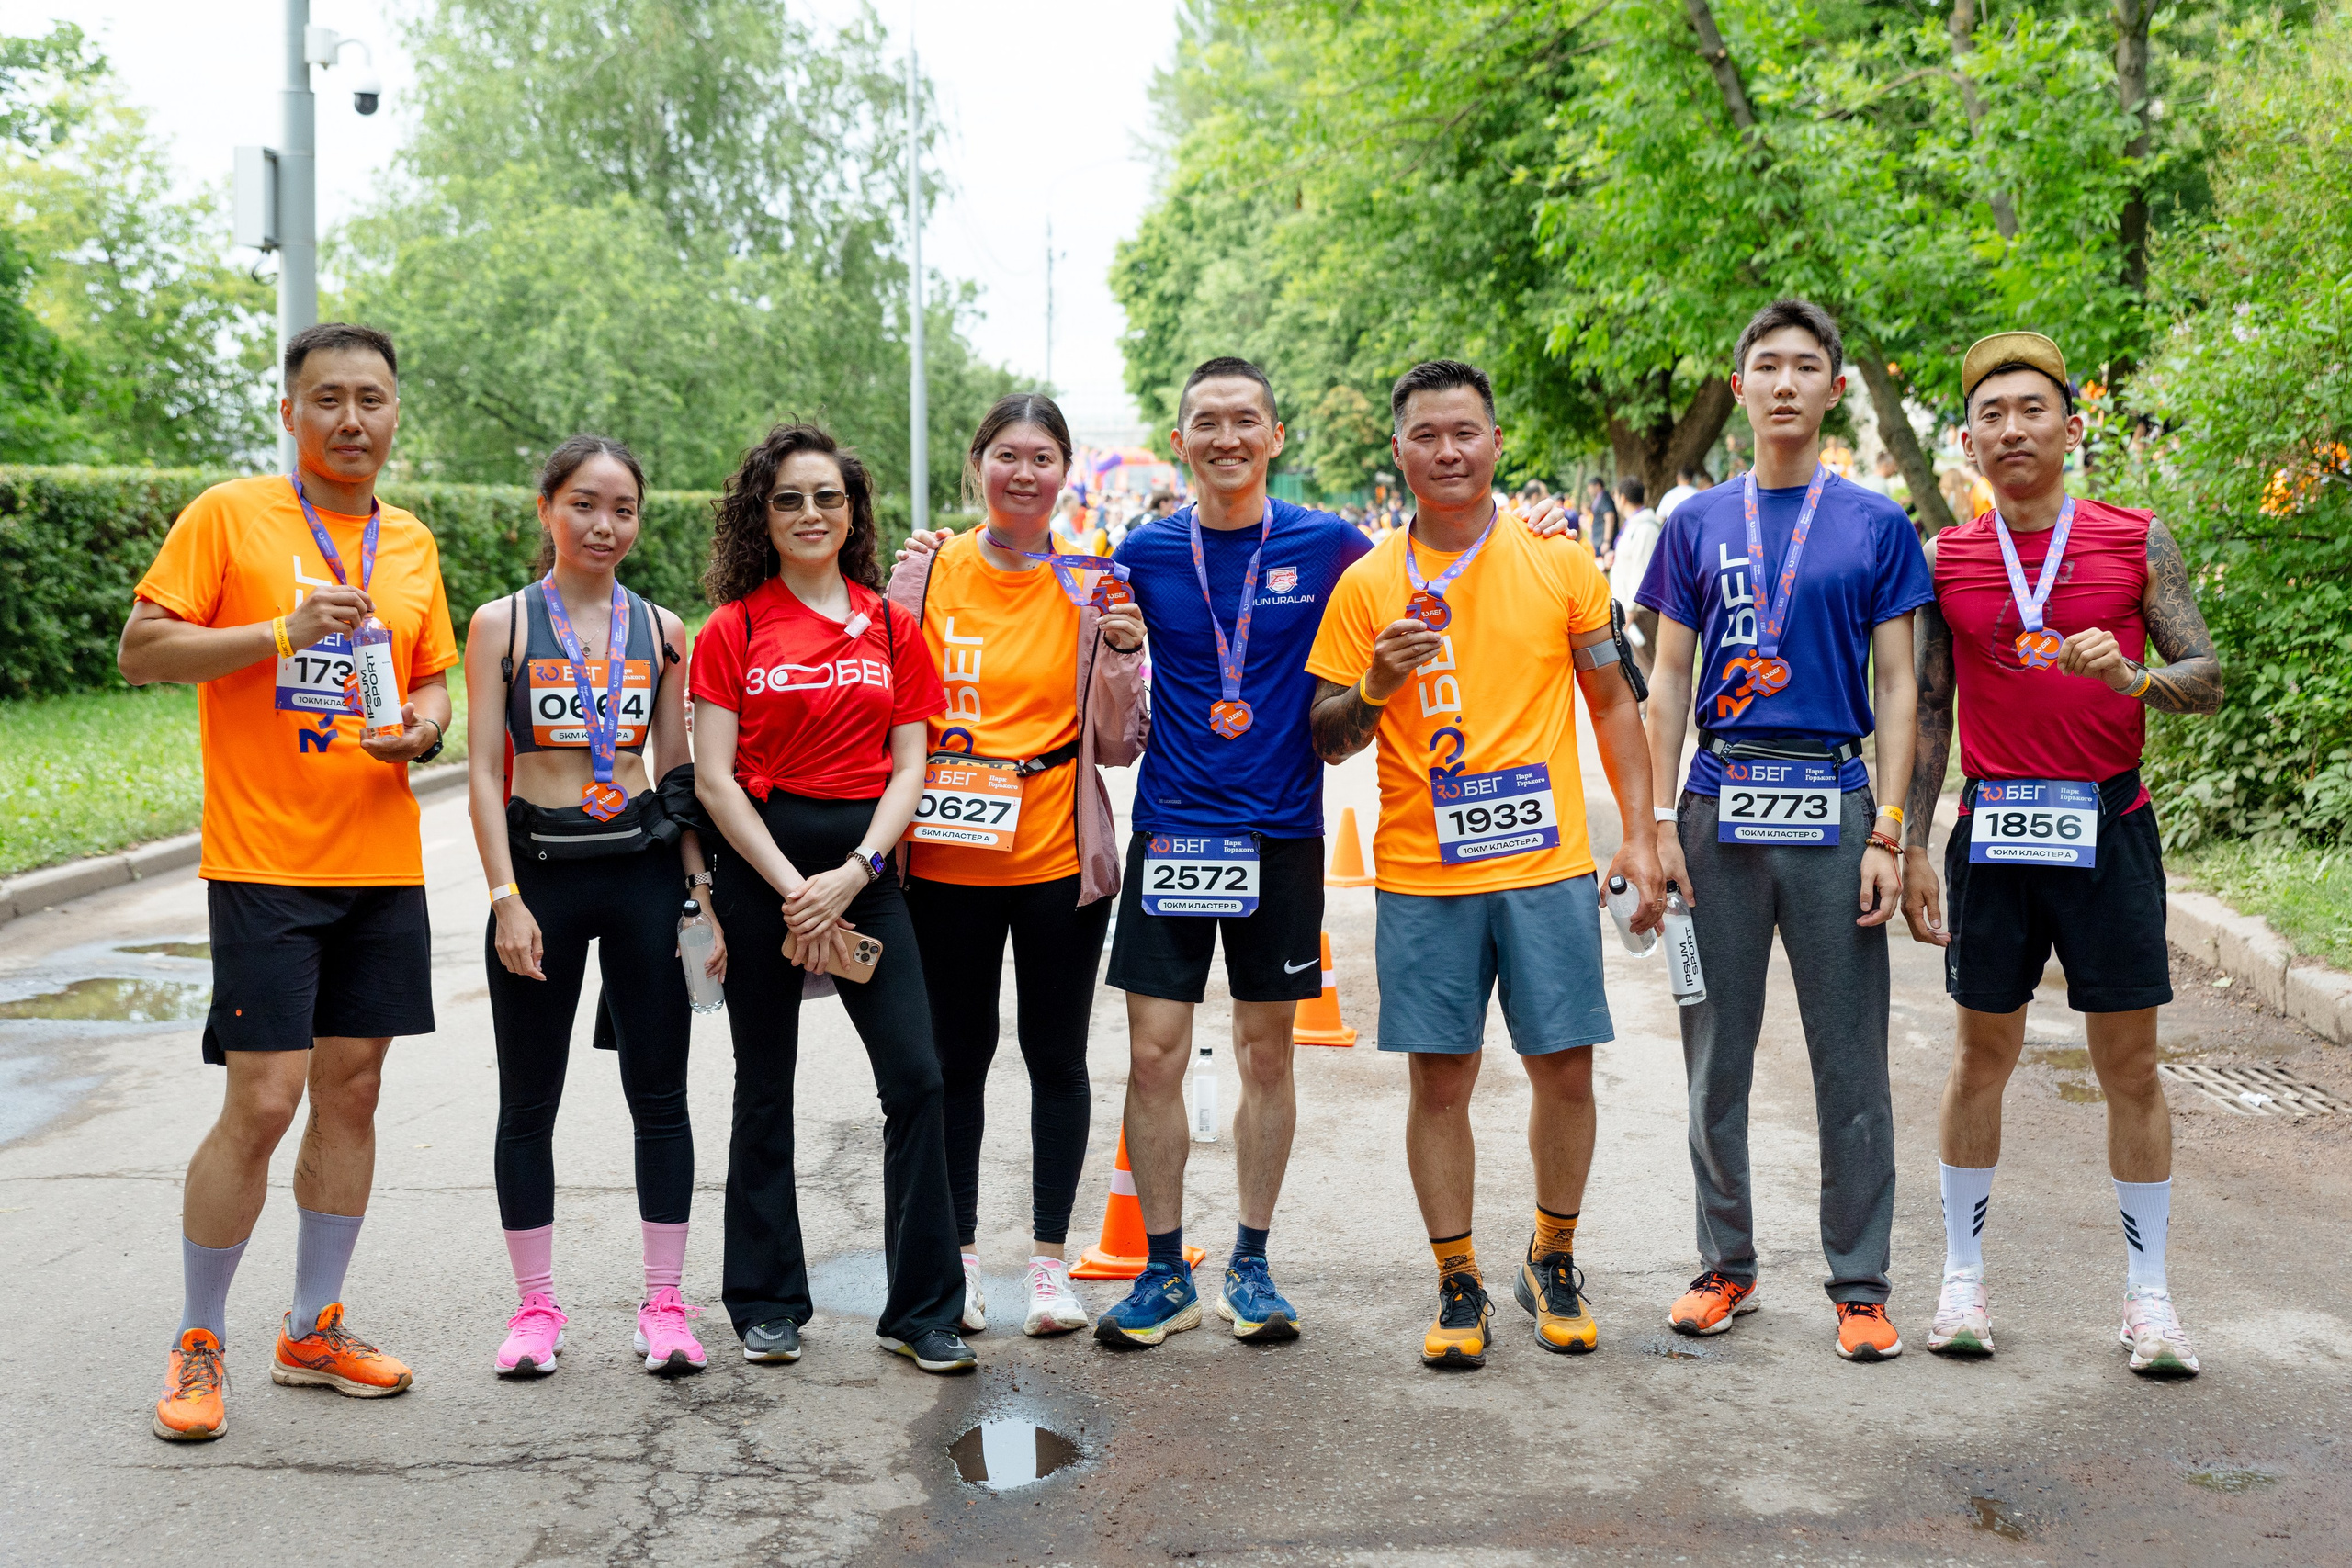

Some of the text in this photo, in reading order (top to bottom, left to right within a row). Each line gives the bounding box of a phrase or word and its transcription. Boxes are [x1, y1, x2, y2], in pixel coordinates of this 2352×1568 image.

[1272, 594, 1315, 604] URALAN
[317, 632, 345, 647] ЕГ
[294, 657, 354, 687] 173
[365, 652, 382, 708] SPORT
[298, 695, 347, 707] 10КМ КЛАС
[360, 669, 375, 719] IPSUM
[924, 770, 978, 786] О.БЕГ
[989, 774, 1007, 783] Парк
[1515, 773, 1532, 781] Парк
[1516, 777, 1545, 787] Горького
[988, 781, 1019, 790] Горького
[1731, 792, 1828, 819] 2773
[2060, 794, 2092, 802] Горького
[914, 795, 1012, 825] 0627
[1449, 799, 1543, 836] 1933
[1985, 812, 2082, 840] 1856
[922, 829, 941, 837] 5КМ
[942, 831, 982, 840] КЛАСТЕР
[1463, 845, 1488, 854] 10КМ
[1489, 838, 1531, 850] КЛАСТЕР
[2019, 850, 2064, 858] КЛАСТЕР
[1153, 865, 1248, 891] 2572
[1685, 926, 1699, 976] SPORT
[1679, 942, 1693, 987] IPSUM
